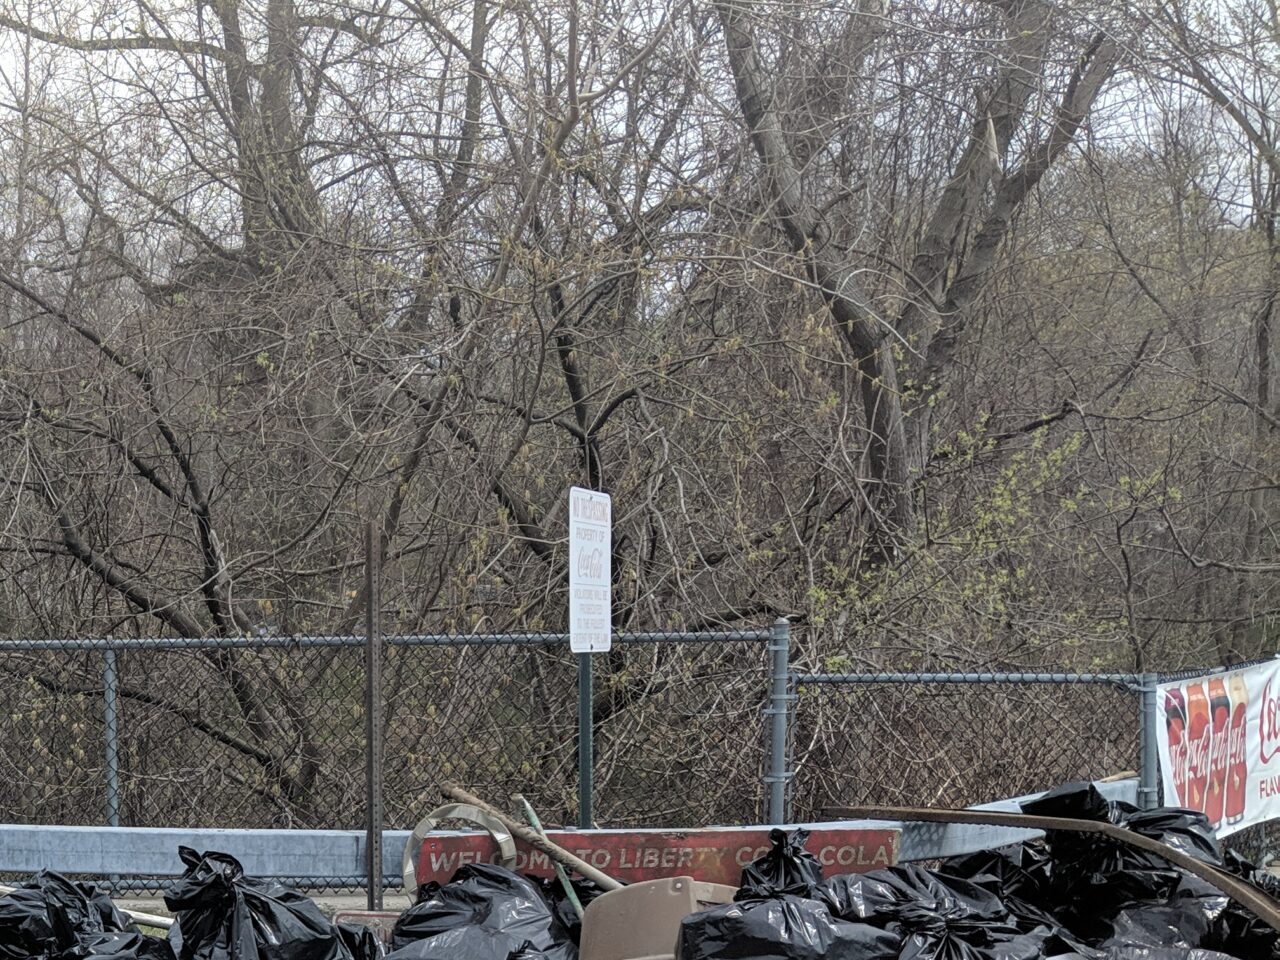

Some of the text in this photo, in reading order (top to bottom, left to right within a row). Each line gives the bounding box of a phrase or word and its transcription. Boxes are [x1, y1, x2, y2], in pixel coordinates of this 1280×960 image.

[429, 850, 556, 873] WELCOM
[576, 849, 611, 868] TO
[619, 847, 725, 869] LIBERTY
